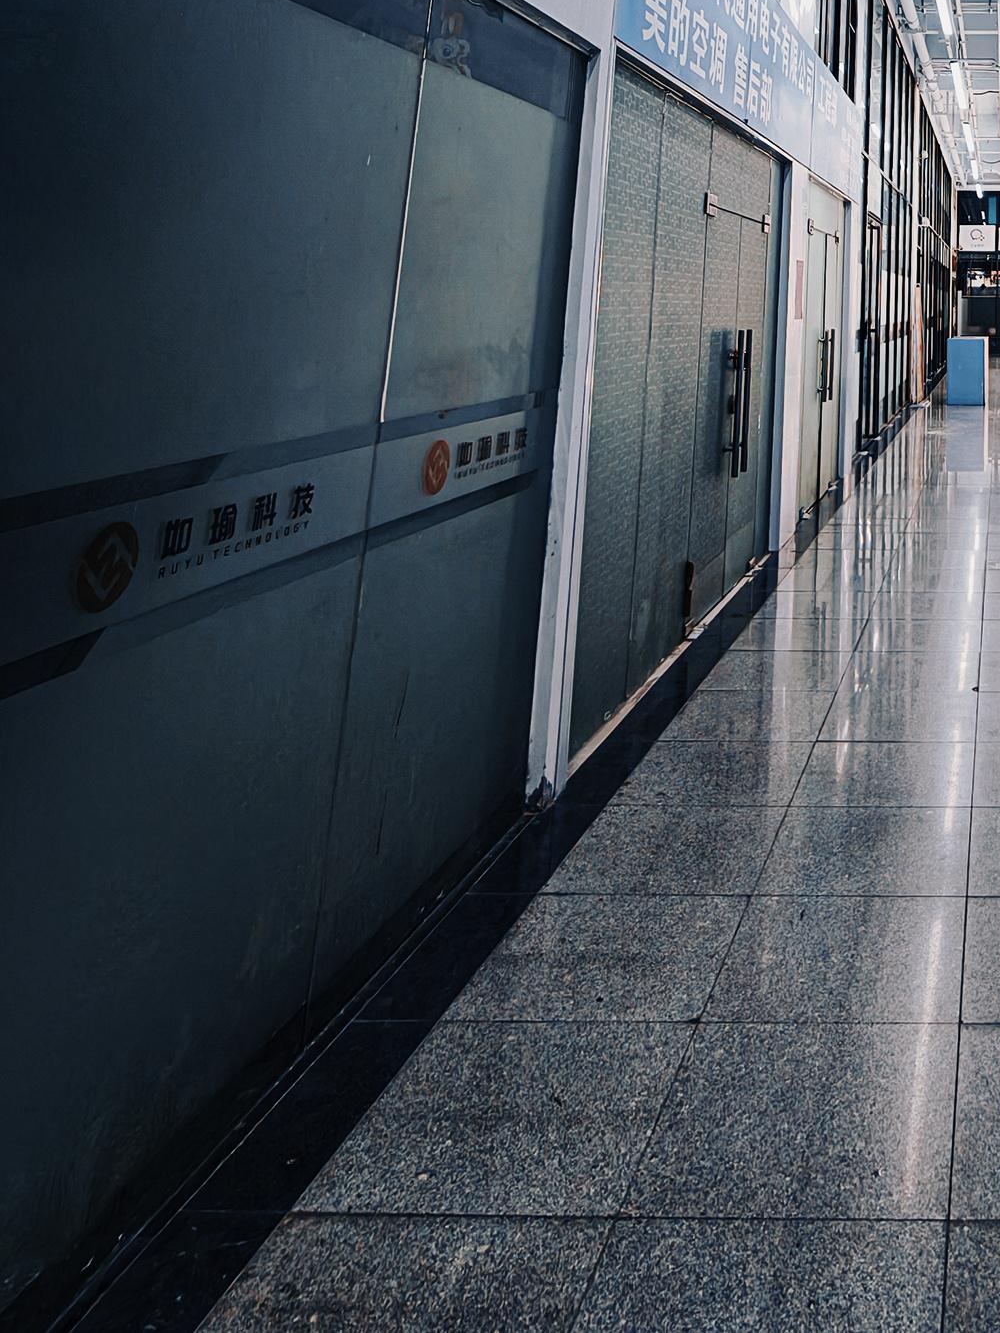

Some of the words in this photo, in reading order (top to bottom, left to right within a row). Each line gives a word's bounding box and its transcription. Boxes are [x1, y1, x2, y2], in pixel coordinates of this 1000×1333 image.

[733, 42, 773, 126] 售后部
[158, 557, 205, 580] RUYU
[213, 520, 309, 562] TECHNOLOGY
[160, 483, 315, 560] 如瑜科技
